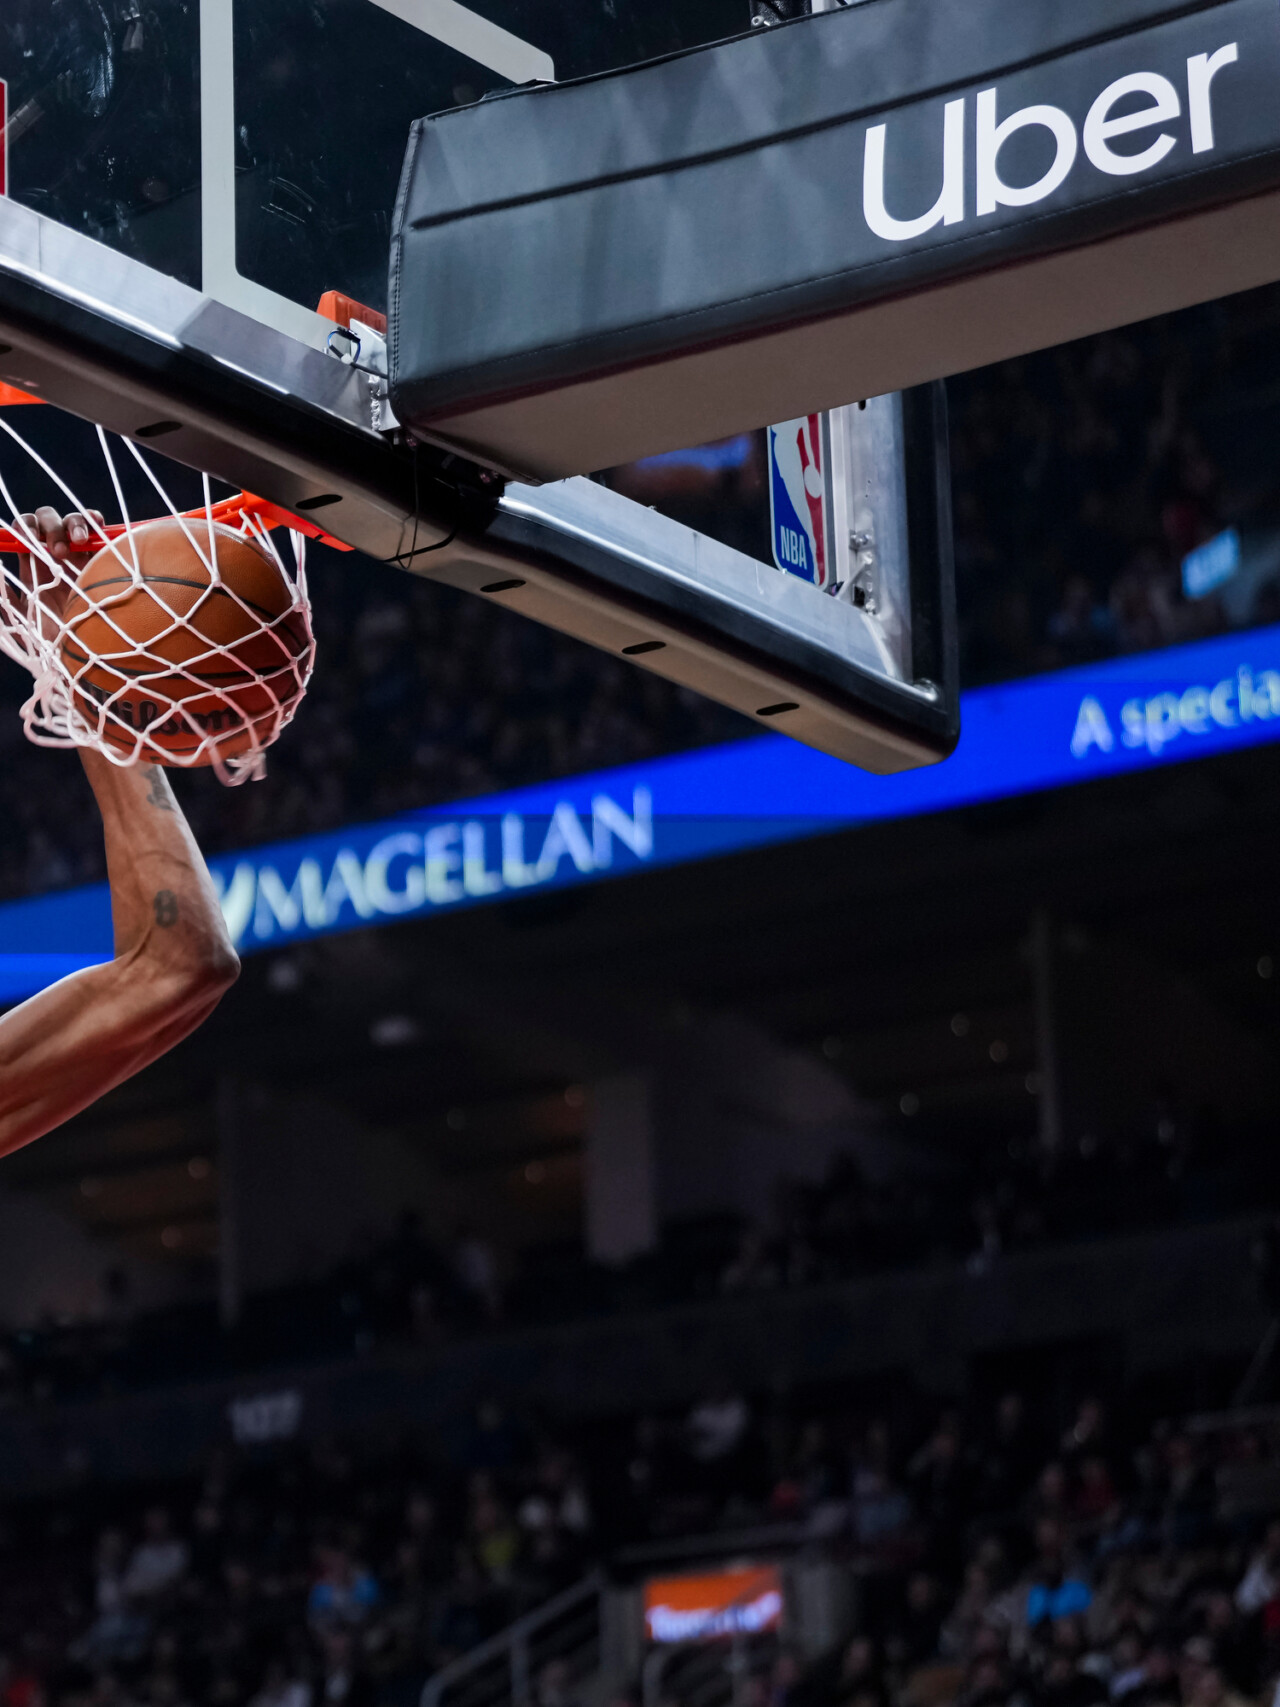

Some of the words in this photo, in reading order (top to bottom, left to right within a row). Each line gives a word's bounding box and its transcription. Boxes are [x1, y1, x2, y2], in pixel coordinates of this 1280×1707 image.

[863, 42, 1238, 241] Uber
[780, 525, 807, 570] NBA
[1071, 694, 1115, 759] A
[255, 784, 653, 938] MAGELLAN
